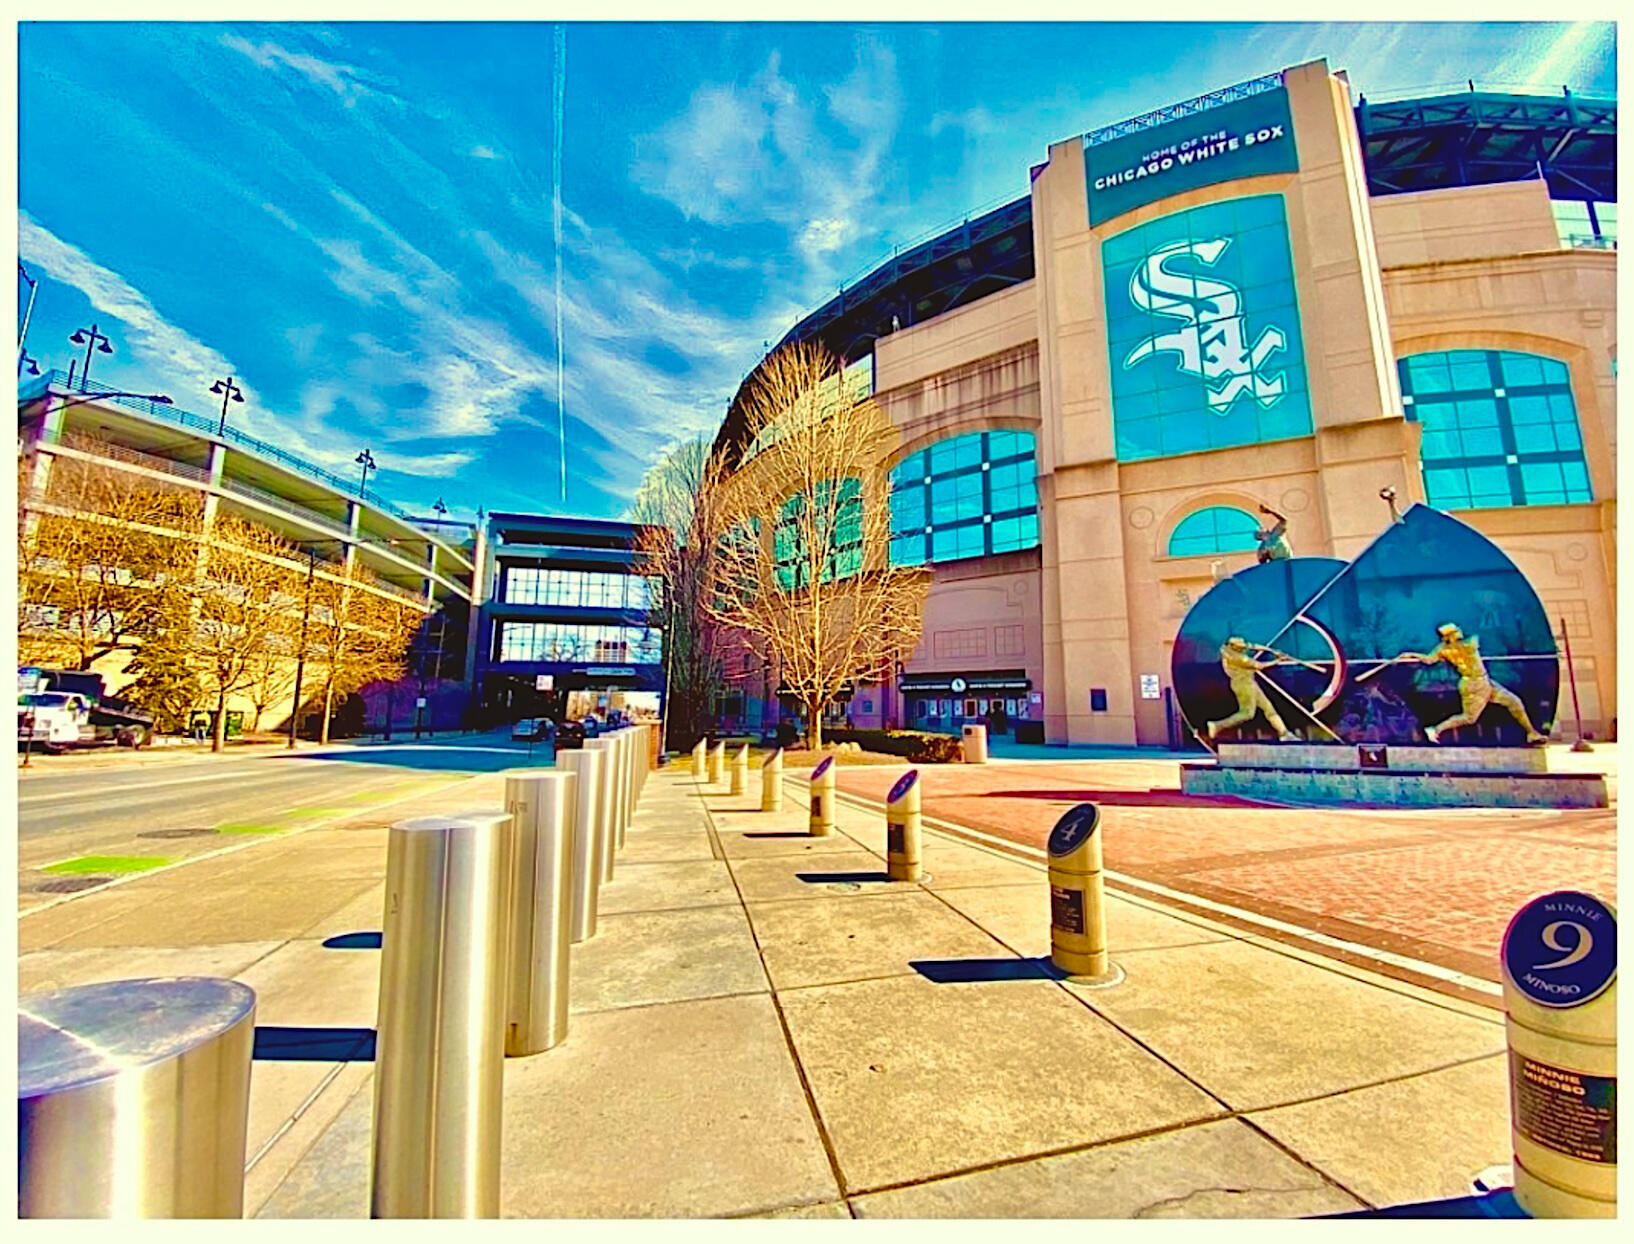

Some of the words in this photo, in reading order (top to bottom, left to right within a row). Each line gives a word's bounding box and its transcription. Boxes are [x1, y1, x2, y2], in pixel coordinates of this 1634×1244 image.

[1094, 157, 1173, 190] CHICAGO
[1177, 137, 1239, 166] WHITE
[1244, 124, 1284, 146] SOX
[1141, 145, 1178, 163] HOME
[1180, 139, 1198, 151] OF
[1202, 130, 1227, 144] THE
[1060, 816, 1085, 842] 4
[1543, 903, 1602, 921] MINNIE
[1532, 921, 1593, 969] 9
[1524, 1061, 1581, 1085] MINNIE
